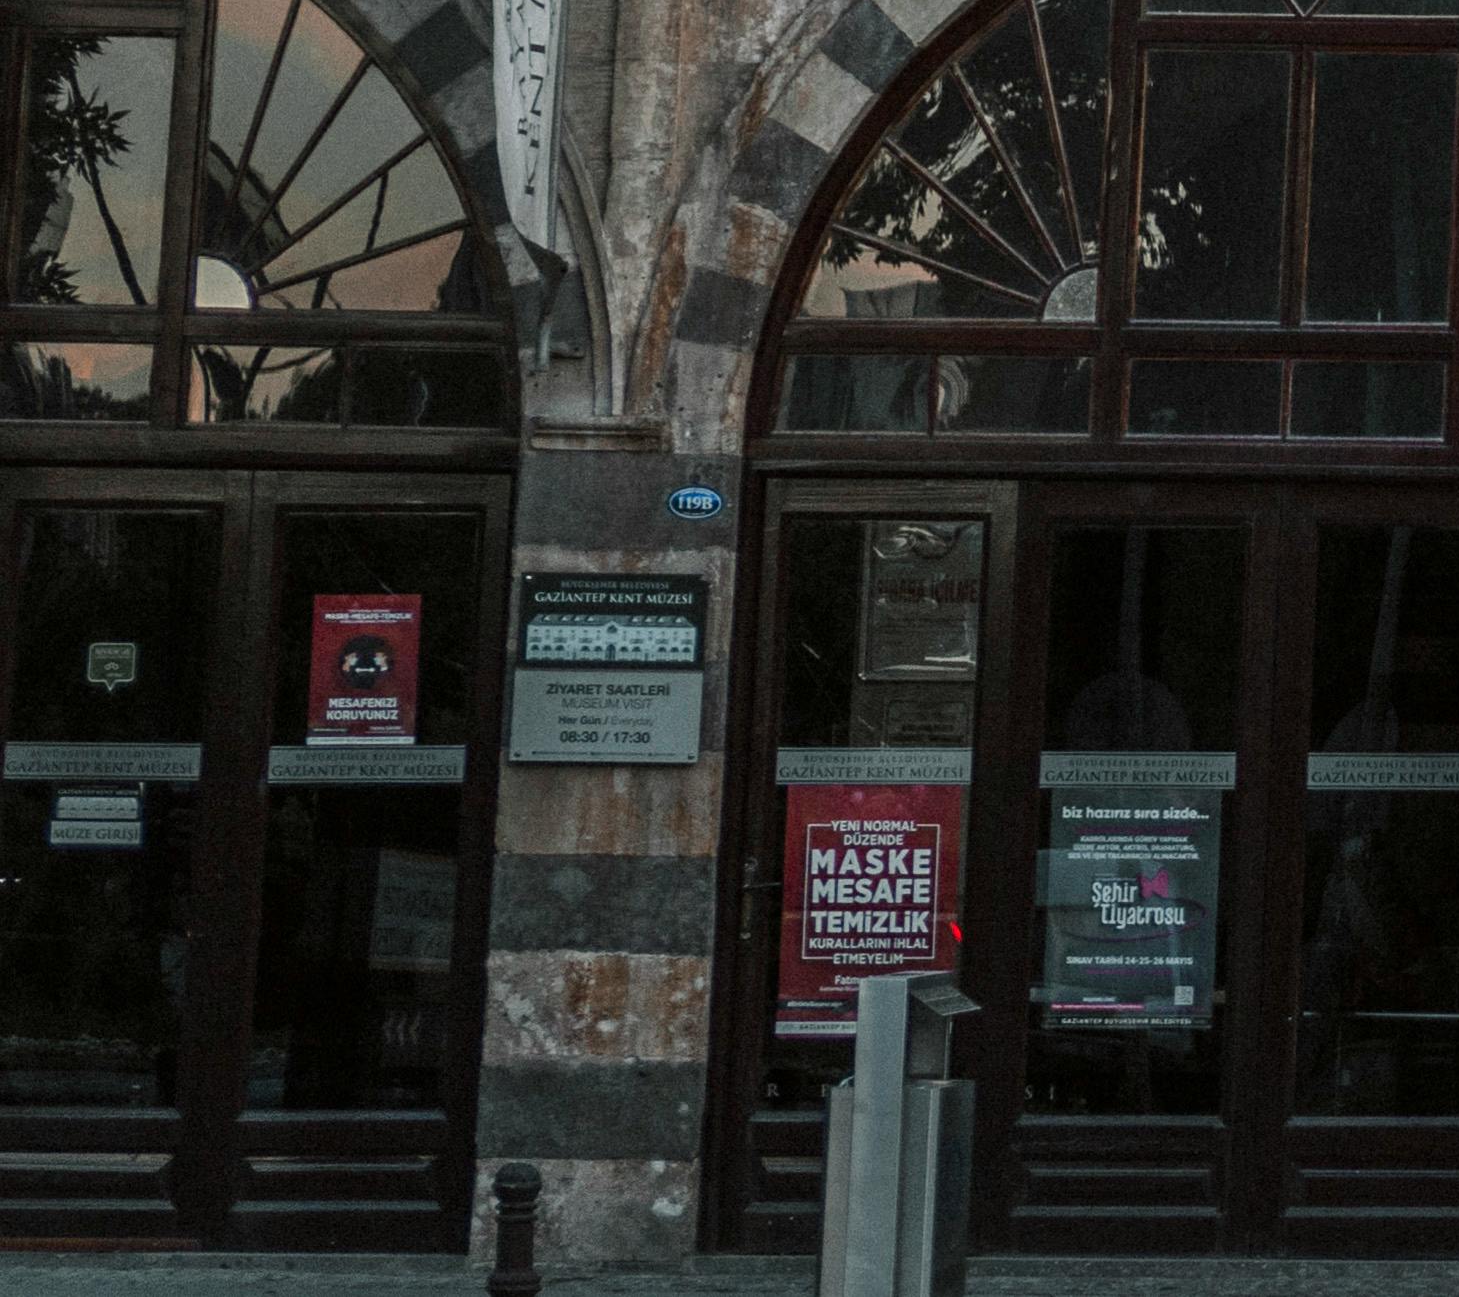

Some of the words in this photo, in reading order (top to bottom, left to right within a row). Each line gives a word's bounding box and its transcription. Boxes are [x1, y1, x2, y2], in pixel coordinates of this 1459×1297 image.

[523, 26, 546, 196] KENT
[678, 495, 713, 510] 119B
[534, 591, 607, 604] GAZİANTEP
[609, 592, 642, 605] KENT
[646, 592, 694, 606] MÜZESİ
[546, 683, 602, 696] ZİYARET
[606, 684, 671, 697] SAATLERİ
[561, 697, 620, 710] MUSEUM
[621, 697, 653, 710] VISIT
[326, 710, 399, 721] KORUYUNUZ
[558, 715, 577, 725] Her
[580, 715, 601, 725] Gün
[560, 731, 599, 744] 08:30
[613, 732, 651, 745] 17:30
[6, 761, 90, 772] GAZİANTEP
[94, 761, 134, 773] KENT
[271, 764, 354, 777] GAZİANTEP
[359, 764, 399, 777] KENT
[403, 763, 458, 777] MÜZESİ
[779, 766, 863, 779] GAZİANTEP
[866, 766, 906, 779] KENT
[910, 766, 964, 779] MÜZESİ
[1045, 770, 1128, 783] GAZİANTEP
[1132, 771, 1172, 783] KENT
[1175, 771, 1230, 783] MÜZESİ
[1311, 771, 1395, 783] GAZİANTEP
[1399, 771, 1438, 783] KENT
[1062, 806, 1083, 819] biz
[1085, 806, 1132, 819] hazırız
[1134, 809, 1160, 819] sıra
[1163, 807, 1210, 820] sizde...
[52, 825, 91, 839] MÜZE
[95, 825, 138, 841] GİRİŞİ
[831, 820, 861, 831] YENİ
[863, 820, 917, 832] NORMAL
[843, 832, 904, 846] DÜZENDE
[811, 848, 932, 875] MASKE
[811, 878, 931, 904] MESAFE
[1091, 881, 1139, 908] Şehir
[811, 910, 930, 934] TEMİZLİK
[809, 937, 891, 949] KURALLARINI
[893, 937, 929, 949] İHLAL
[832, 953, 904, 965] ETMEYELİM
[1165, 956, 1194, 966] MAYIS
